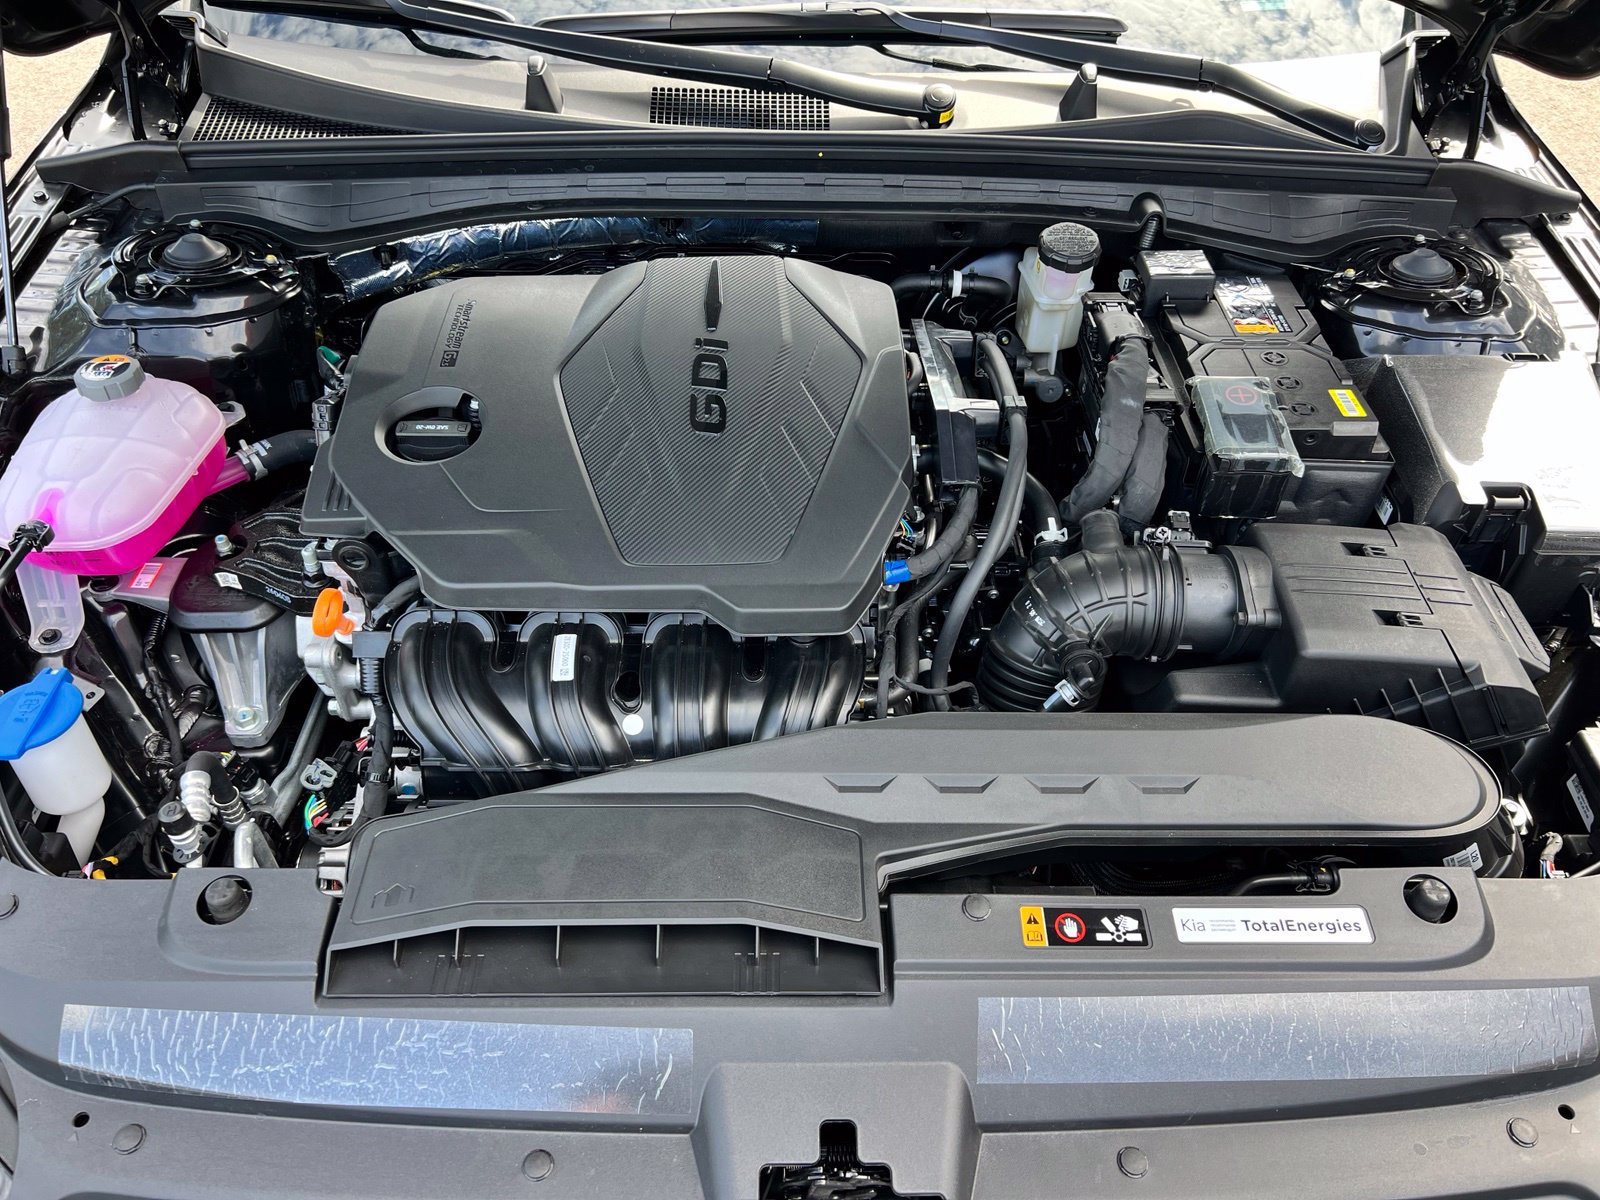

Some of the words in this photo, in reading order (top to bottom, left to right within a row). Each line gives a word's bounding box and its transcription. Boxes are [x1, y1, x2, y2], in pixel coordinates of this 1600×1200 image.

[445, 303, 465, 349] TECHNOLOGY
[452, 298, 477, 349] Smartstream
[1180, 918, 1206, 933] Kia
[1240, 918, 1362, 934] TotalEnergies
